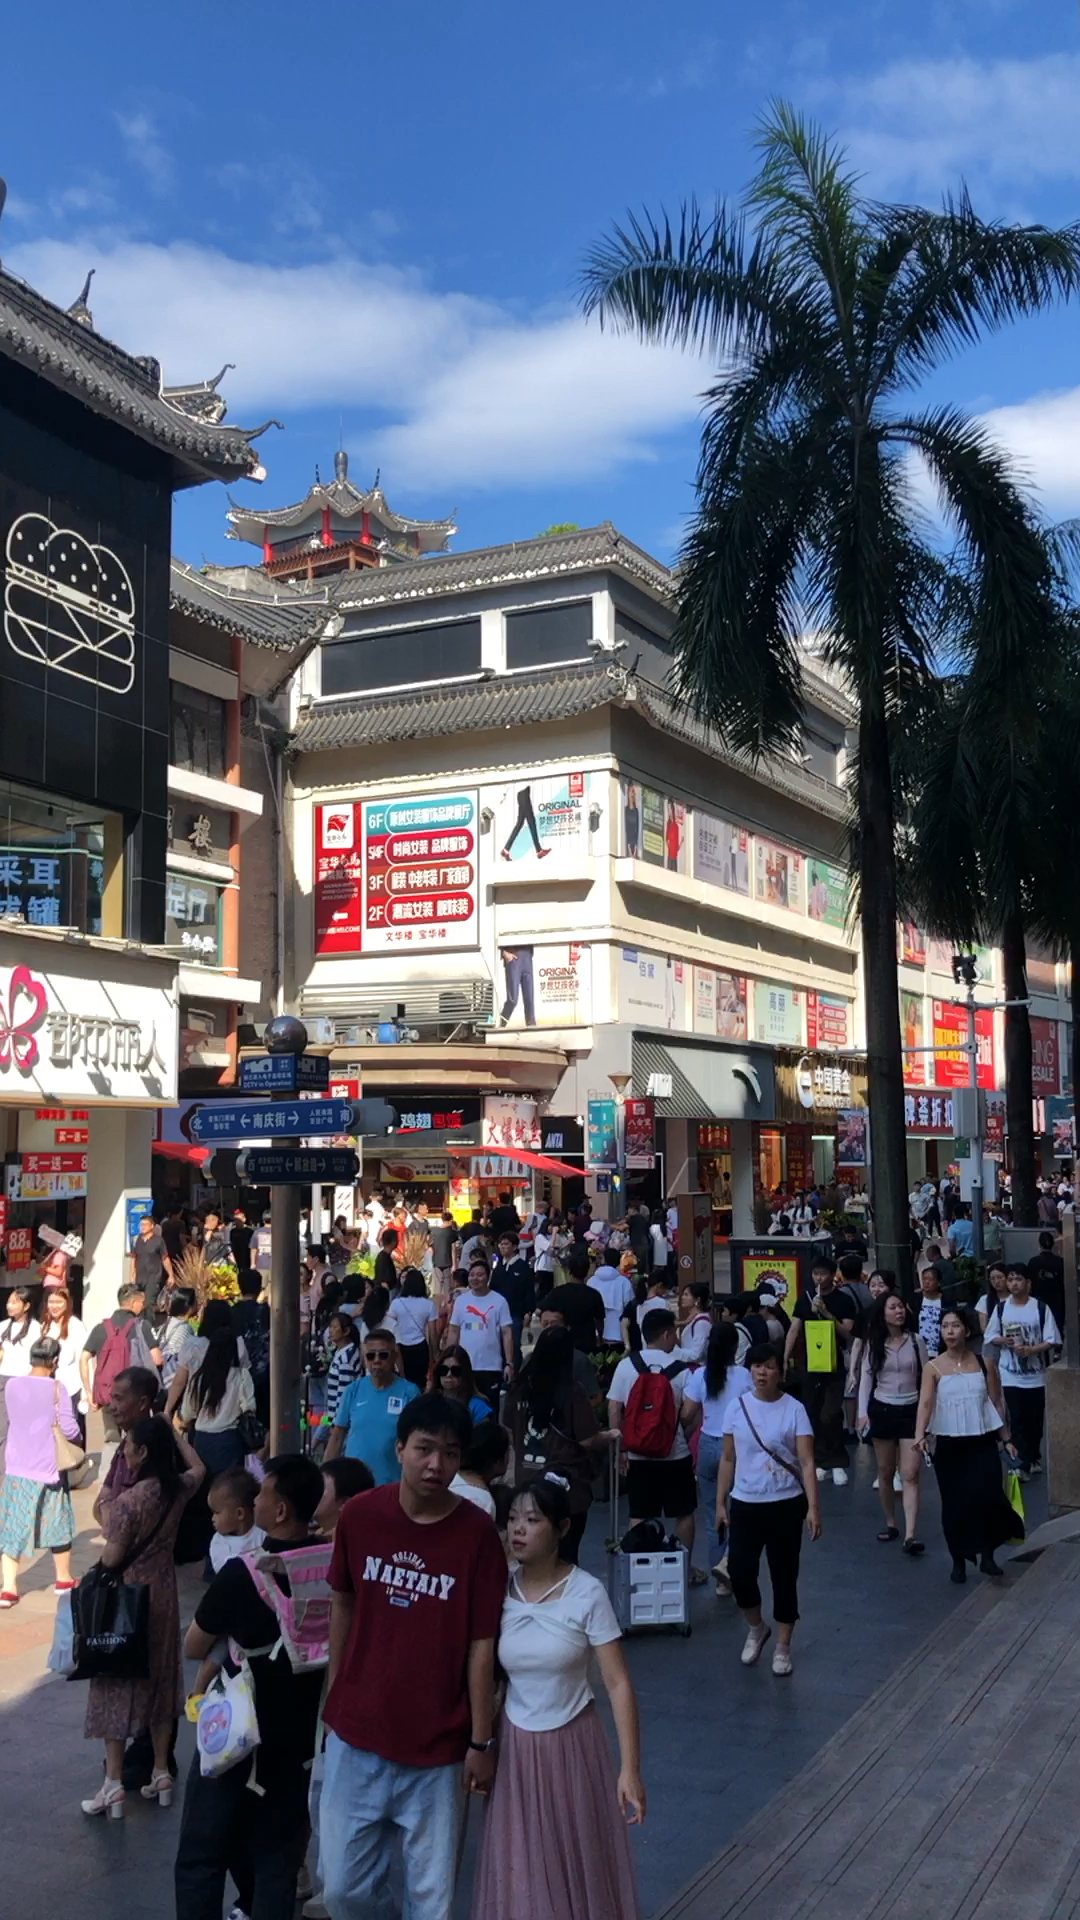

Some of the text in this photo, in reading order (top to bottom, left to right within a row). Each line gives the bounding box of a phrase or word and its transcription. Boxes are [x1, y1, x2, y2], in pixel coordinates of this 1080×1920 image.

[538, 799, 582, 812] ORIGINAL
[368, 813, 384, 829] 6F
[0, 856, 60, 891] 采耳
[368, 874, 385, 891] 3F
[368, 905, 384, 921] 2F
[193, 1119, 204, 1130] 北
[252, 1111, 287, 1129] 南庆街
[339, 1109, 350, 1123] 南
[400, 1111, 465, 1129] 鸡翅包饭
[58, 1130, 88, 1143] 买一送一
[545, 1132, 564, 1149] ANTA
[28, 1155, 73, 1171] 买一送一
[85, 1635, 128, 1647] FASHION
